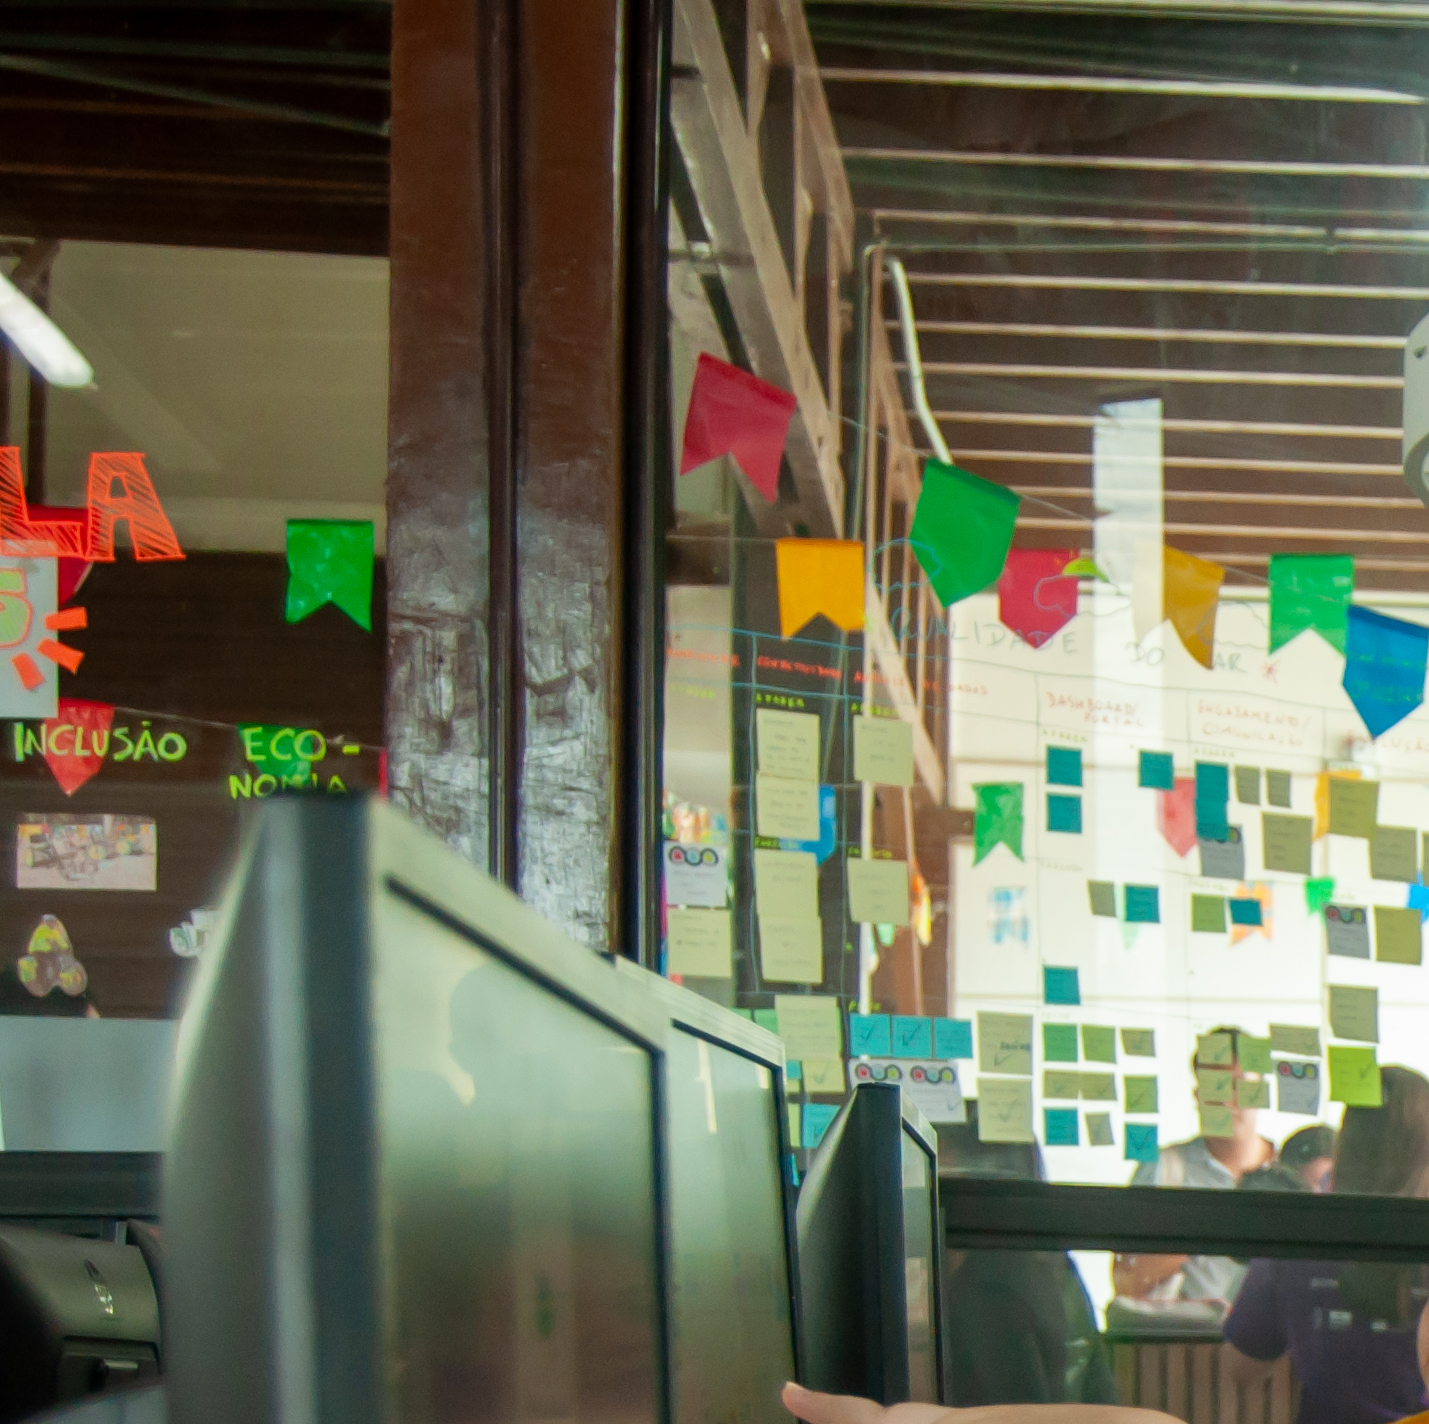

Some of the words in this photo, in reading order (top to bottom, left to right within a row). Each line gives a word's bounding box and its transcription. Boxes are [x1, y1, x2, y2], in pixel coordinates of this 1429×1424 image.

[889, 606, 1078, 654] QUALIDADE
[1125, 642, 1165, 666] DO
[1214, 651, 1247, 673] AR
[13, 720, 187, 763] INCLUSÃO
